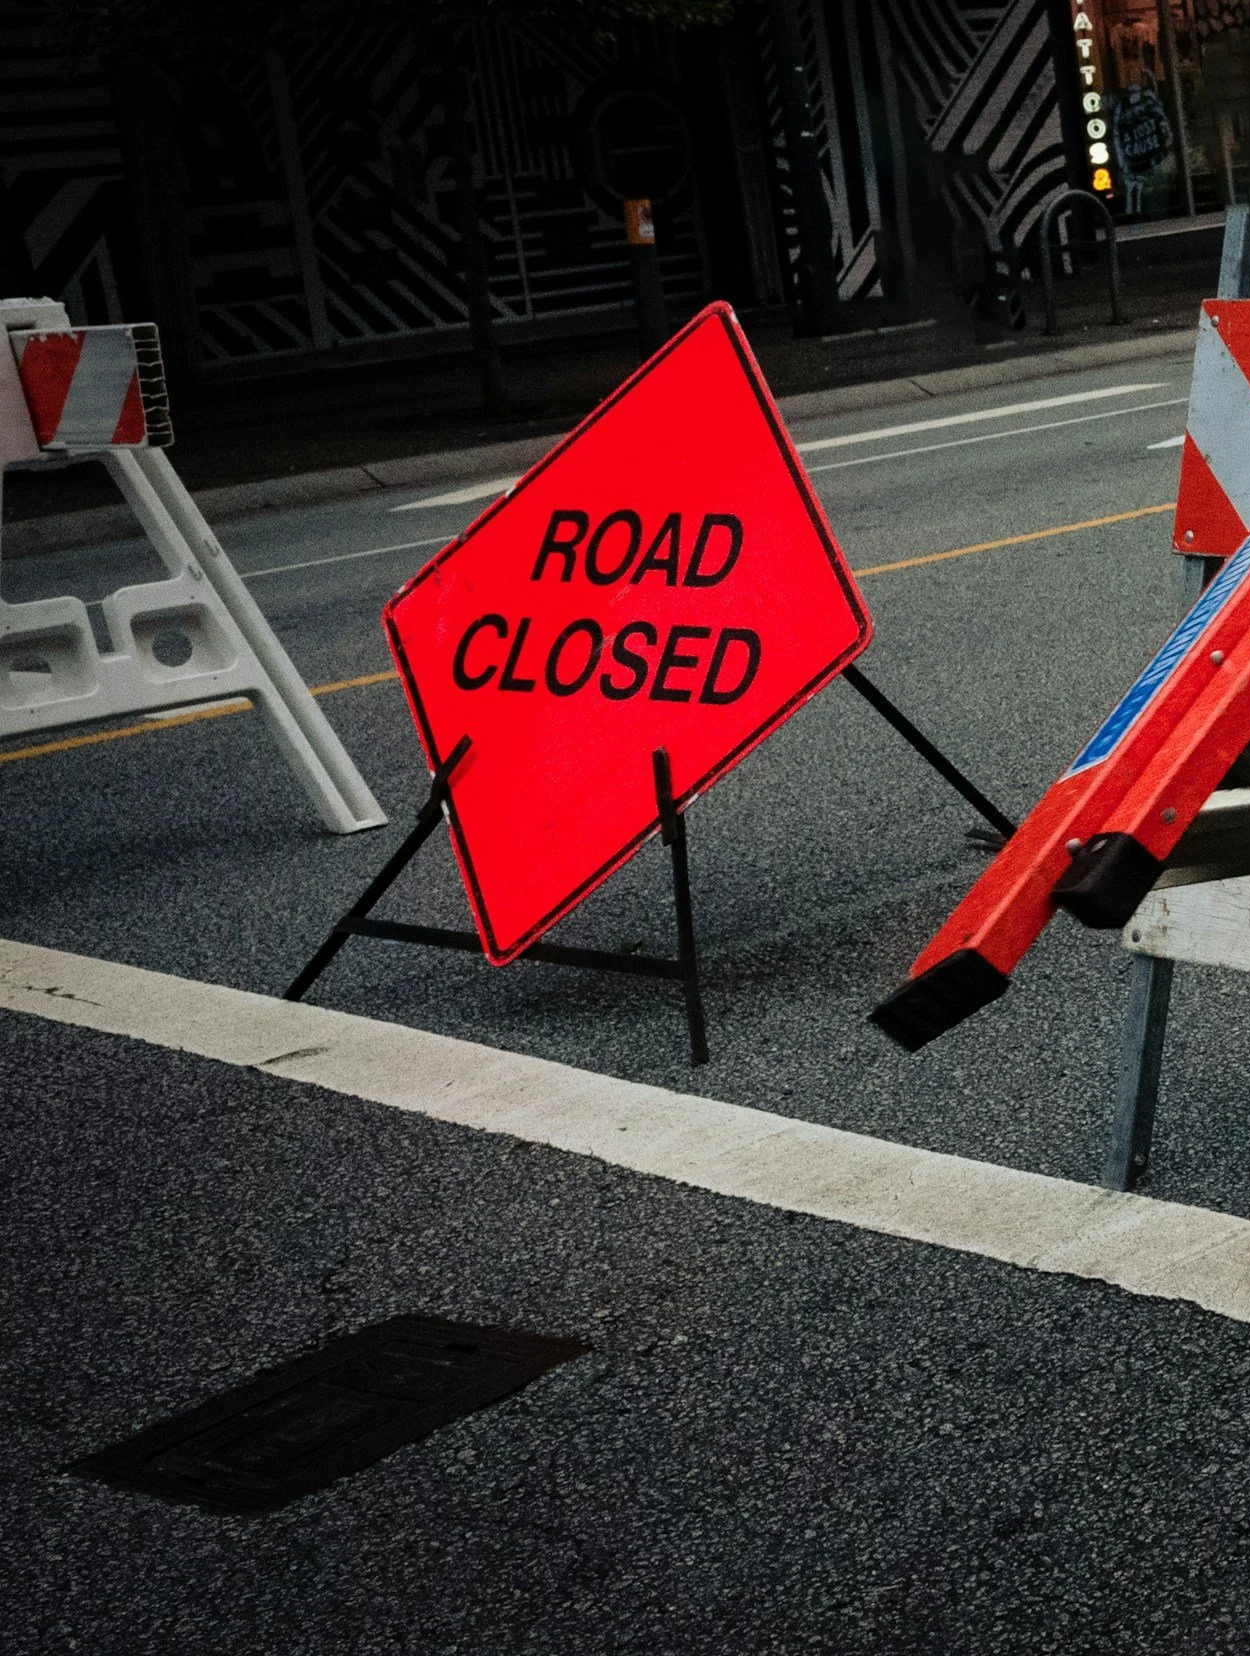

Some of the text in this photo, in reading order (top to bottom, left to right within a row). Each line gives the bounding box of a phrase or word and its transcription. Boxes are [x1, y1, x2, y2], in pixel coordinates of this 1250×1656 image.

[1073, 0, 1112, 191] ATTOOS &
[531, 510, 743, 587] ROAD
[453, 614, 761, 705] CLOSED
